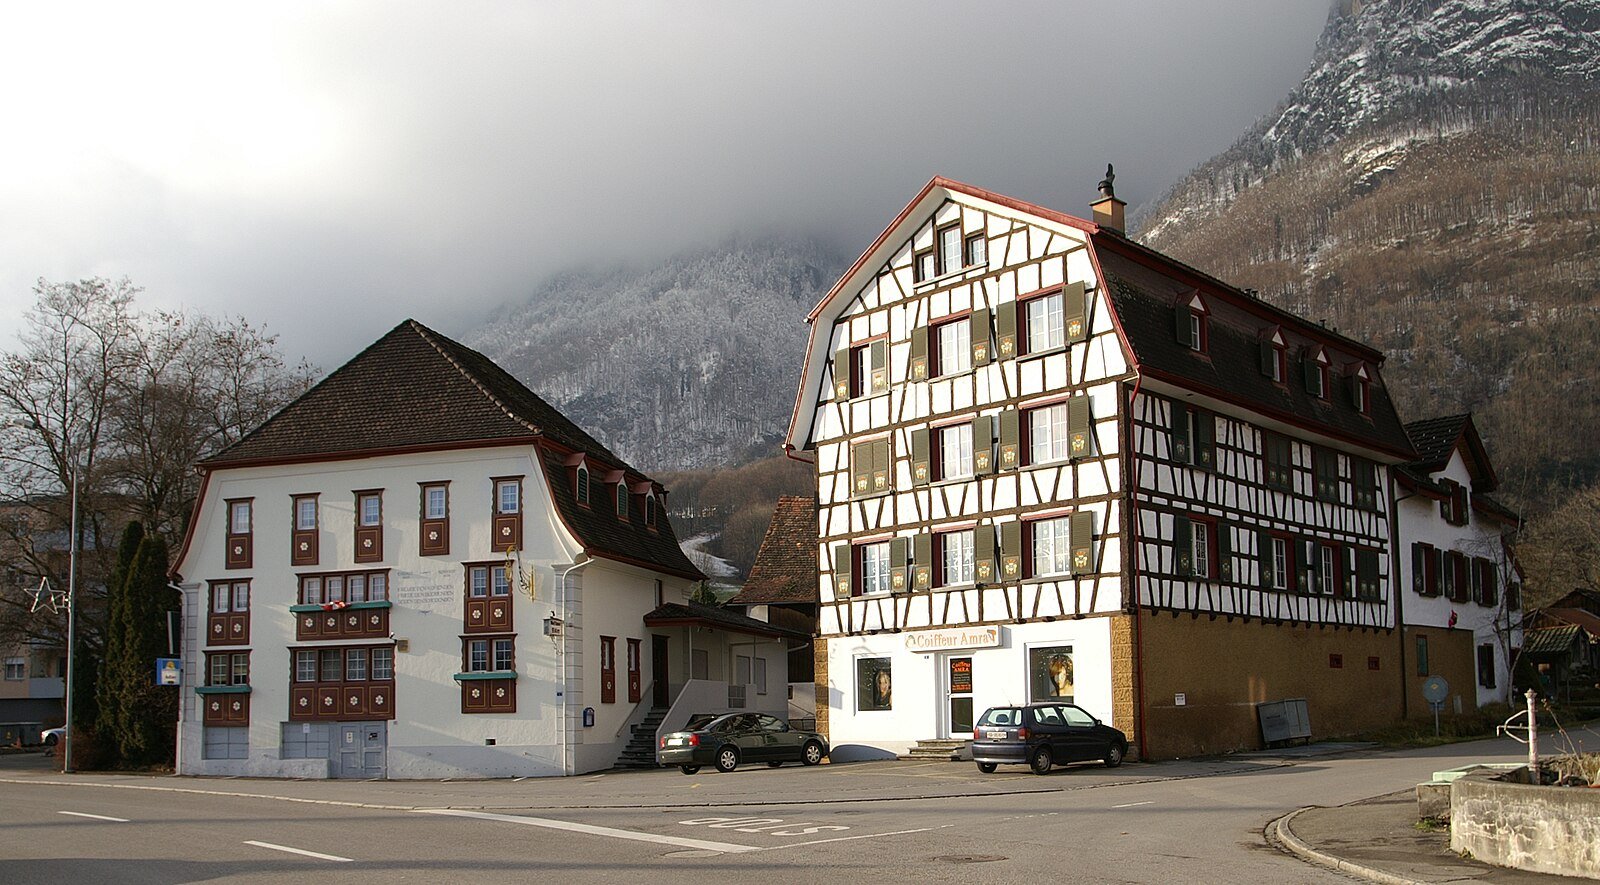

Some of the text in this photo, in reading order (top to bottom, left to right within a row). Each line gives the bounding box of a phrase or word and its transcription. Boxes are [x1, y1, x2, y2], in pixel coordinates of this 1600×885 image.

[917, 632, 989, 648] Coiffeur Amra
[678, 816, 850, 836] STOP
